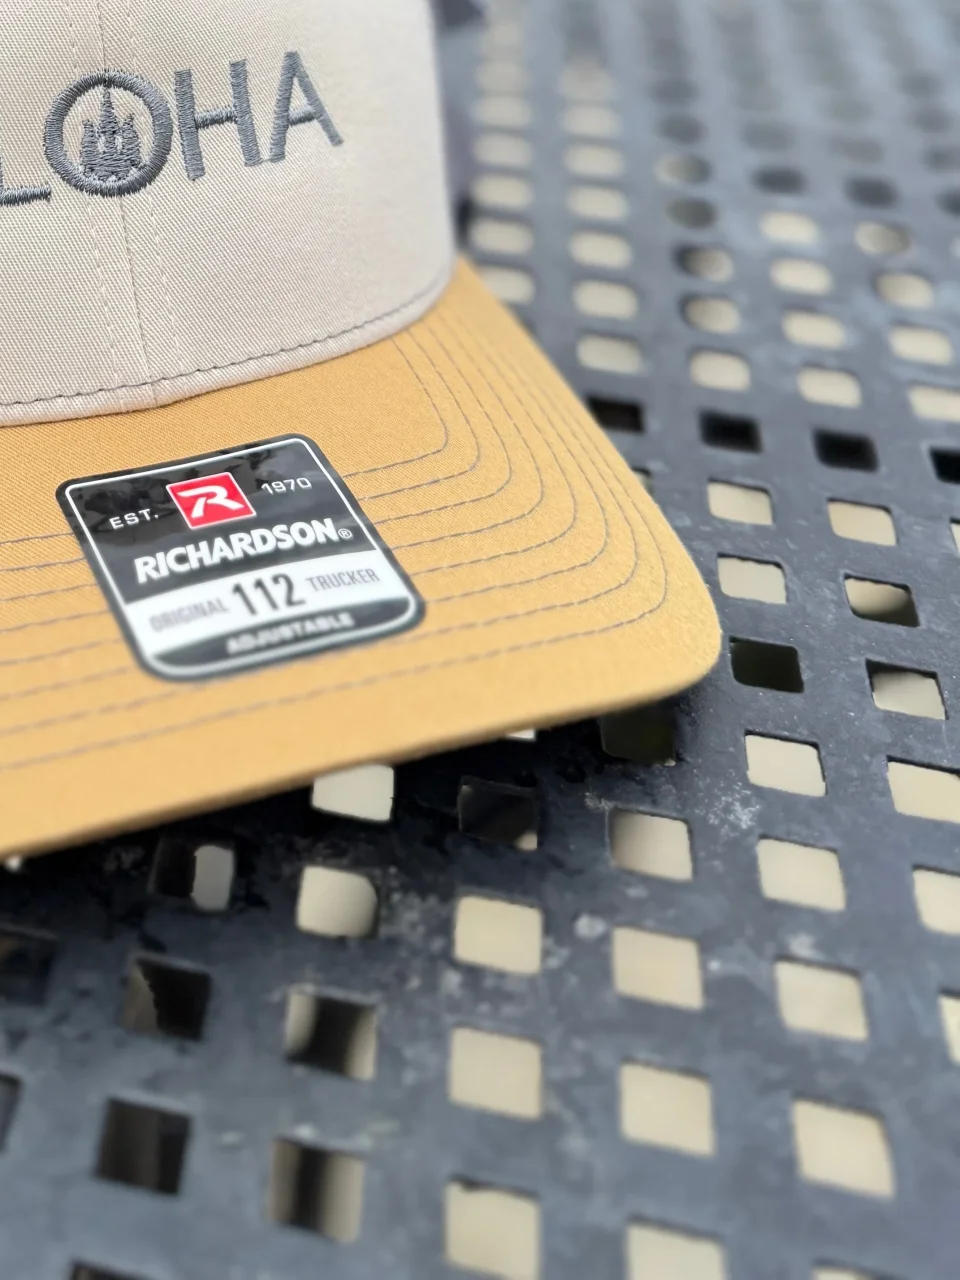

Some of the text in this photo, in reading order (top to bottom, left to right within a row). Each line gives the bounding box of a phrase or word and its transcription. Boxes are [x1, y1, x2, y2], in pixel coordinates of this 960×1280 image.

[109, 508, 160, 530] EST.
[261, 477, 312, 495] 1970
[149, 568, 381, 632] ORIGINAL 112 TRUCKER
[226, 612, 356, 655] ADJUSTABLE
